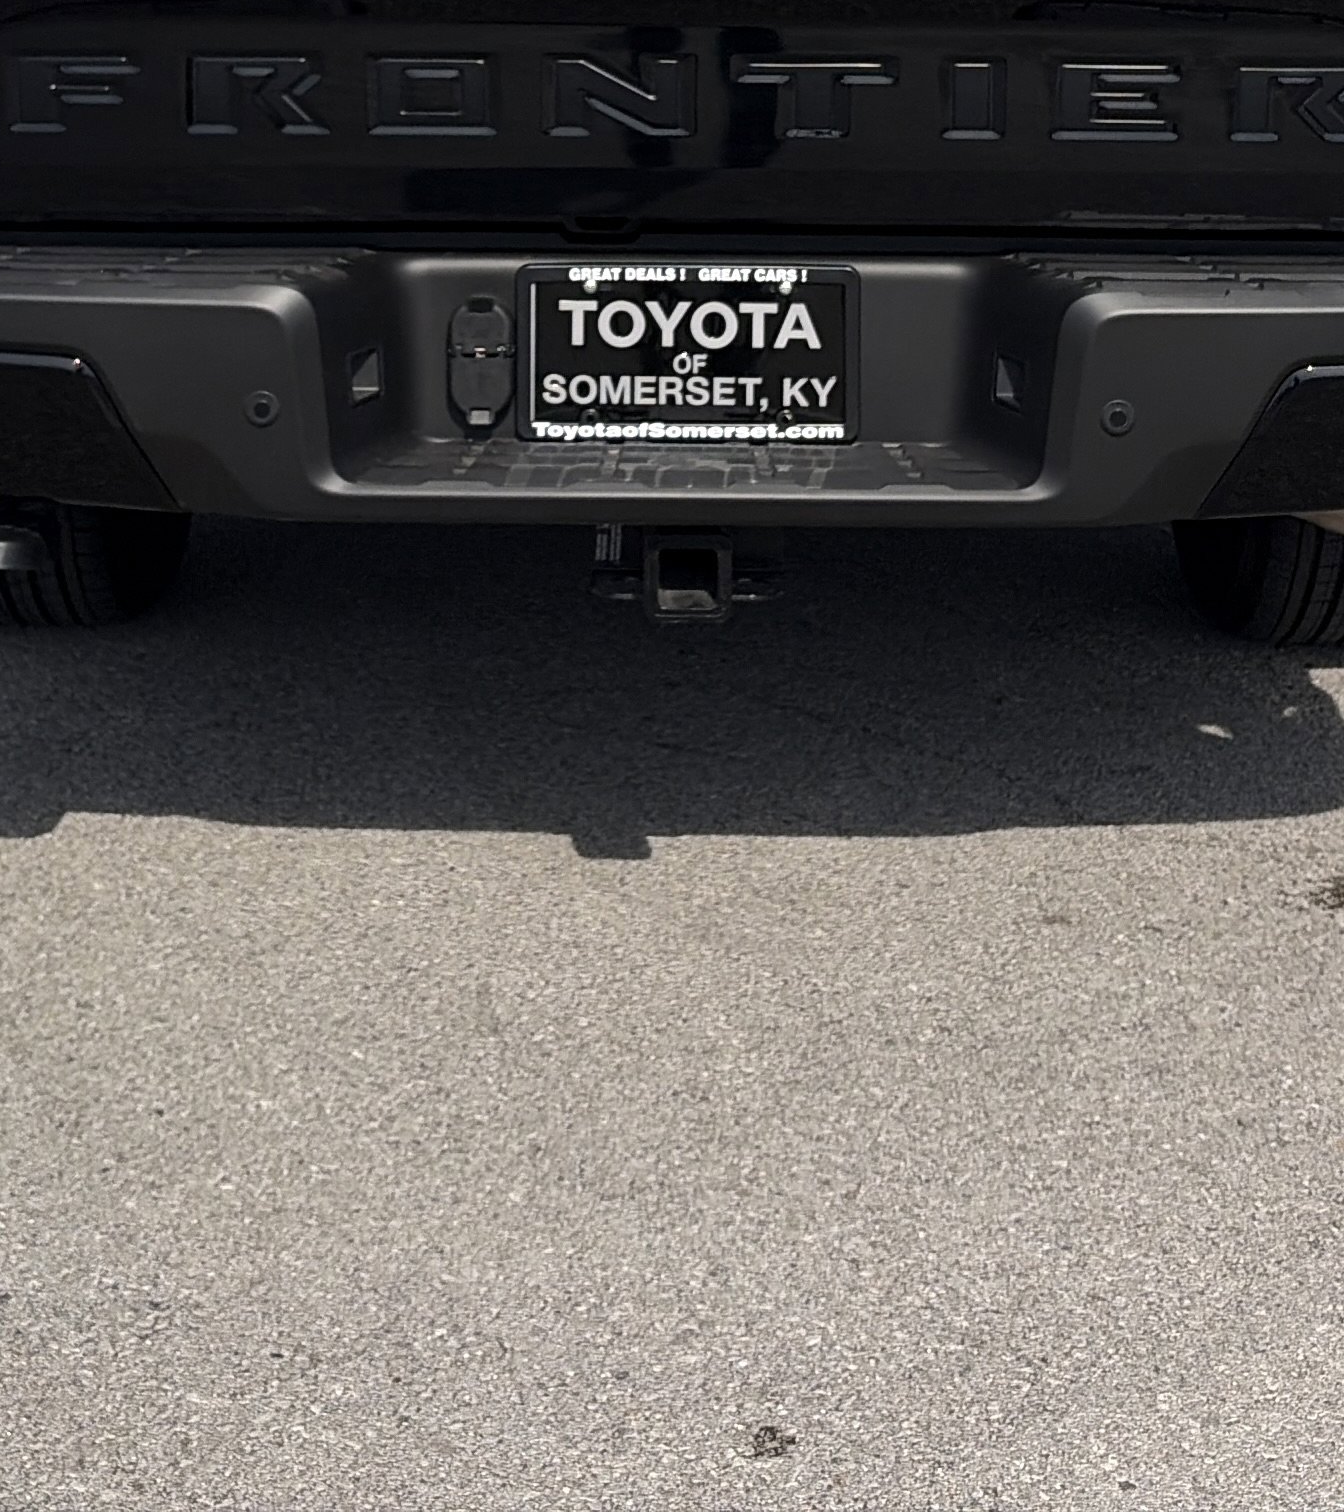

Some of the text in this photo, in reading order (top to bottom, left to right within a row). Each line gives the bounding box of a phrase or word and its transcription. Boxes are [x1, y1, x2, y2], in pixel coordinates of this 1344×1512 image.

[568, 267, 620, 282] GREAT
[698, 268, 751, 282] GREAT
[558, 299, 822, 350] TOYOTA
[672, 353, 708, 375] OF
[542, 373, 837, 412] SOMERSET, KY
[532, 421, 845, 441] ToyotaofSomerset.com
